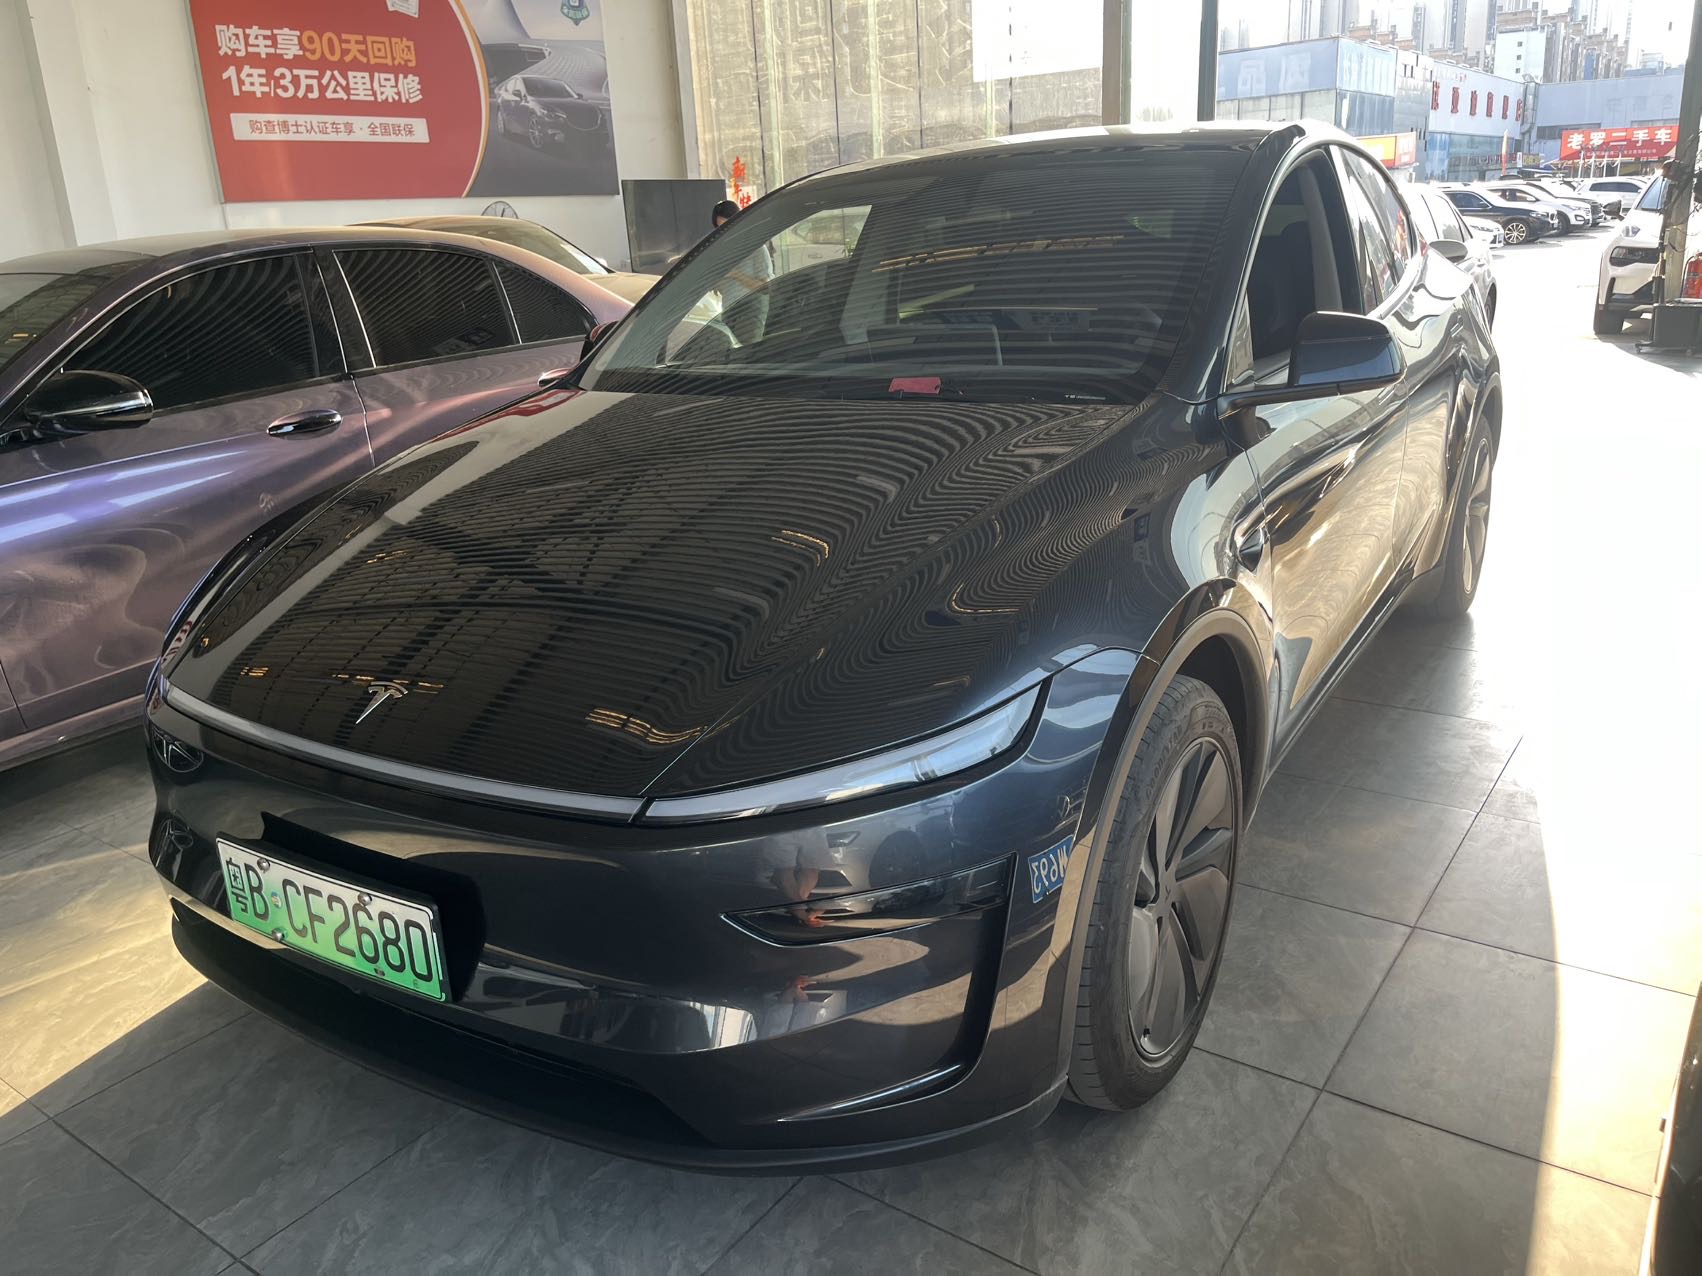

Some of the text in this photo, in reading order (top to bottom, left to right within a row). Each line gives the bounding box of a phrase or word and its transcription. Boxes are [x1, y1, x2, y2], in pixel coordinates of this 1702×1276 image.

[215, 24, 417, 67] 购车享90天回购
[1567, 128, 1672, 149] 老罗二手车
